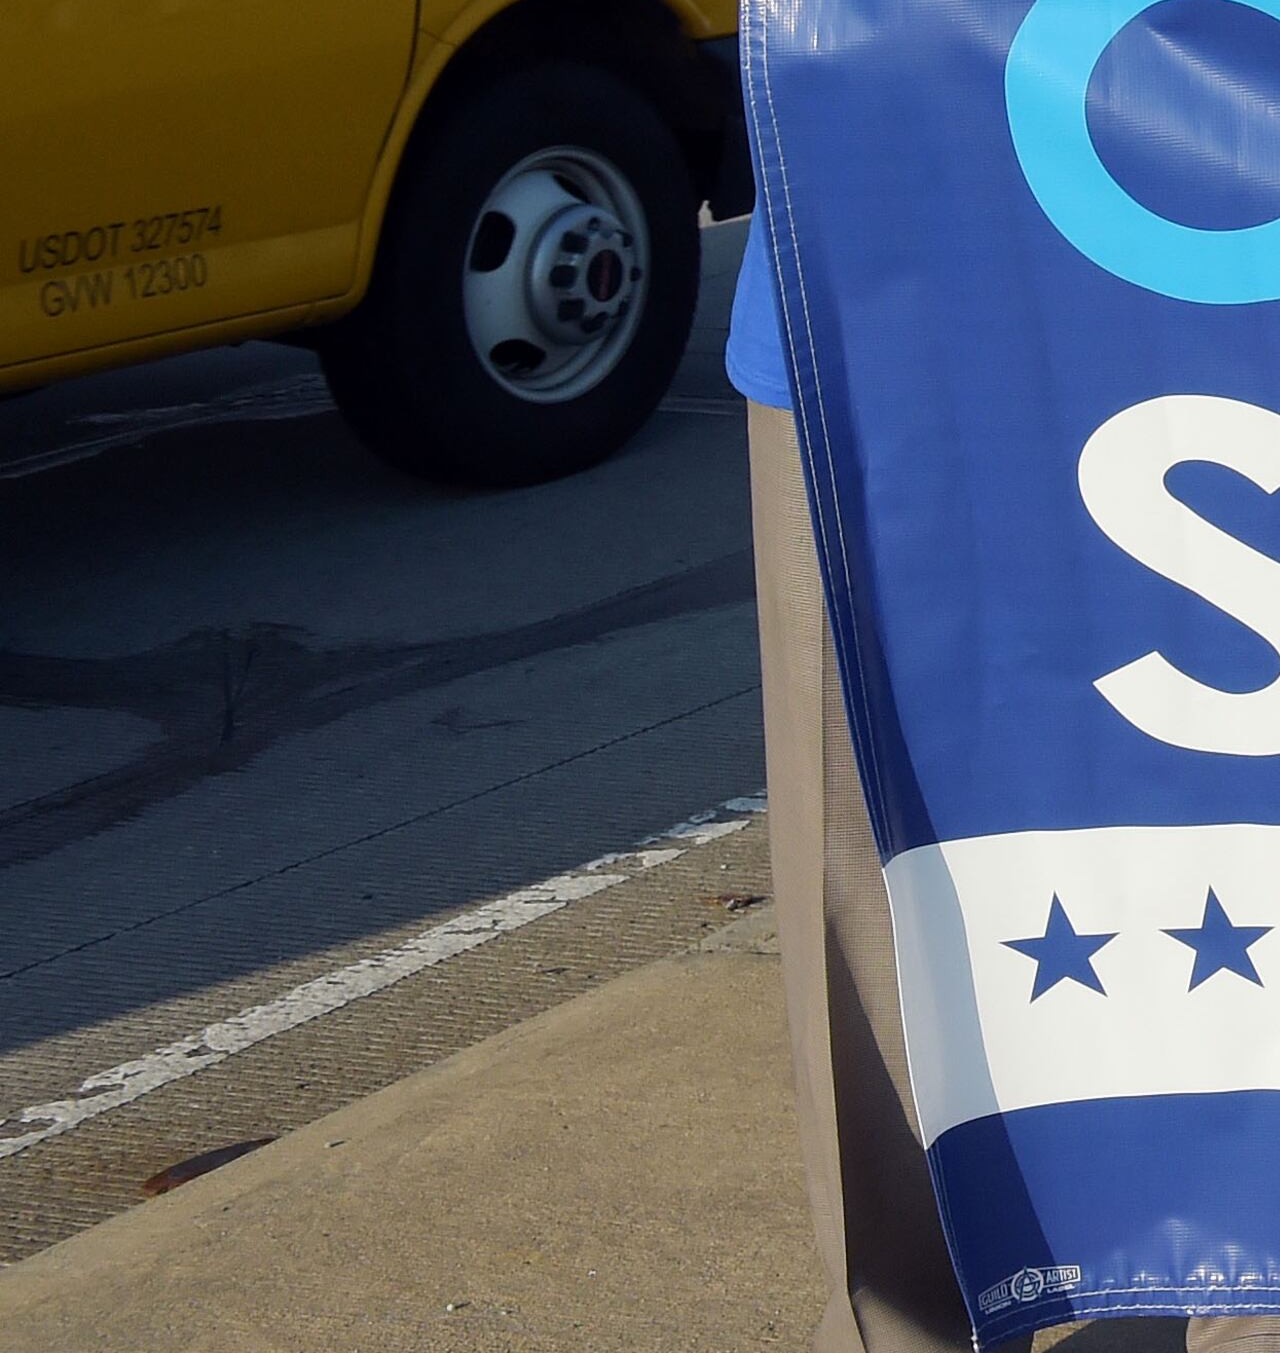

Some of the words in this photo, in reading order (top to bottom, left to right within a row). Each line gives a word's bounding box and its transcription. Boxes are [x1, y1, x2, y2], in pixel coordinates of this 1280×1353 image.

[18, 221, 126, 274] USDOT
[130, 204, 222, 253] 327574
[39, 269, 113, 318] GVW
[122, 252, 208, 299] 12300
[1045, 1269, 1077, 1284] ARTIST
